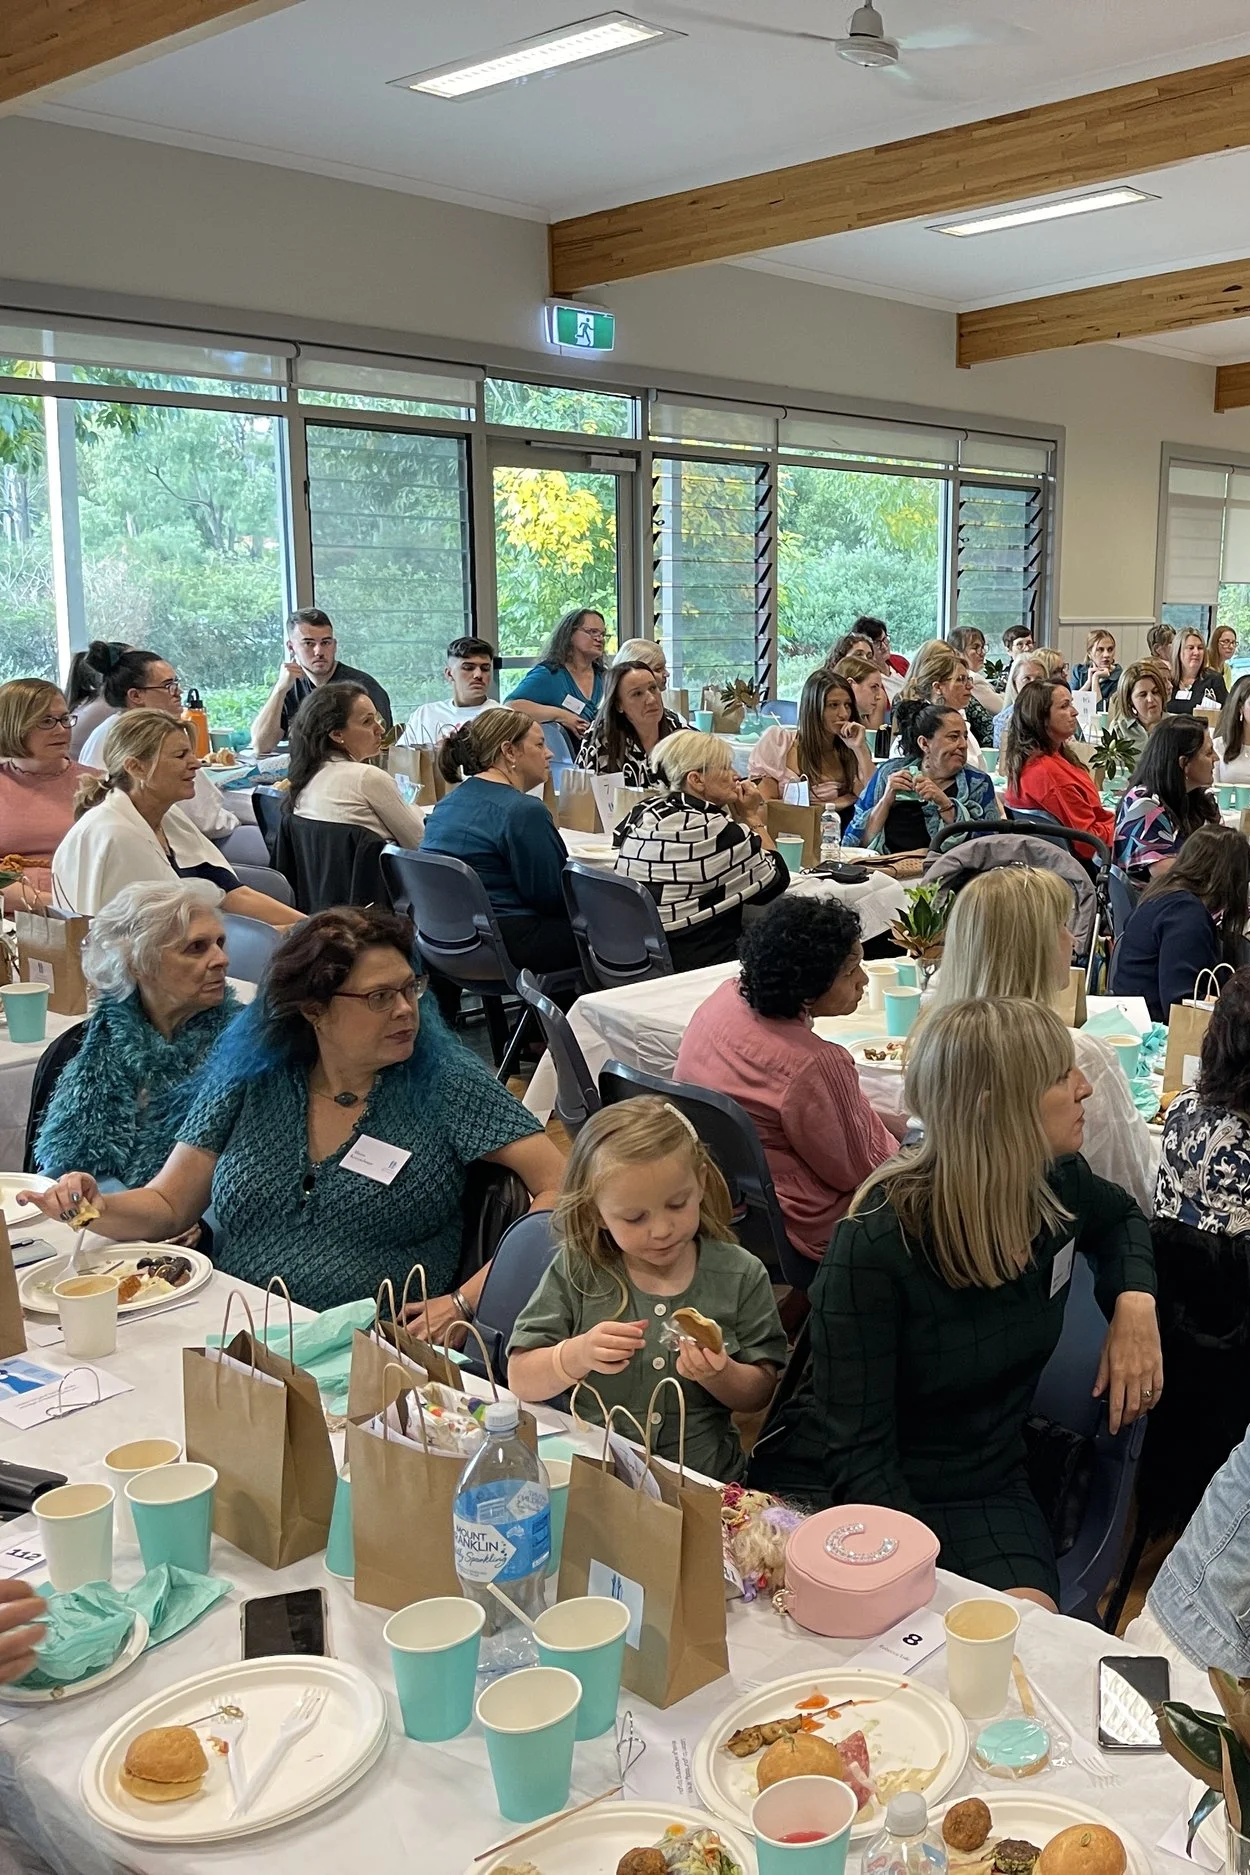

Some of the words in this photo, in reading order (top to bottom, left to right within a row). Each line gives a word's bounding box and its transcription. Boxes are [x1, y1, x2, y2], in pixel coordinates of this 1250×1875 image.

[455, 1531, 498, 1551] ANKLIN
[456, 1525, 487, 1541] MOUNT
[824, 1523, 900, 1566] C
[465, 1551, 507, 1568] Sparkling
[902, 1633, 923, 1646] 8
